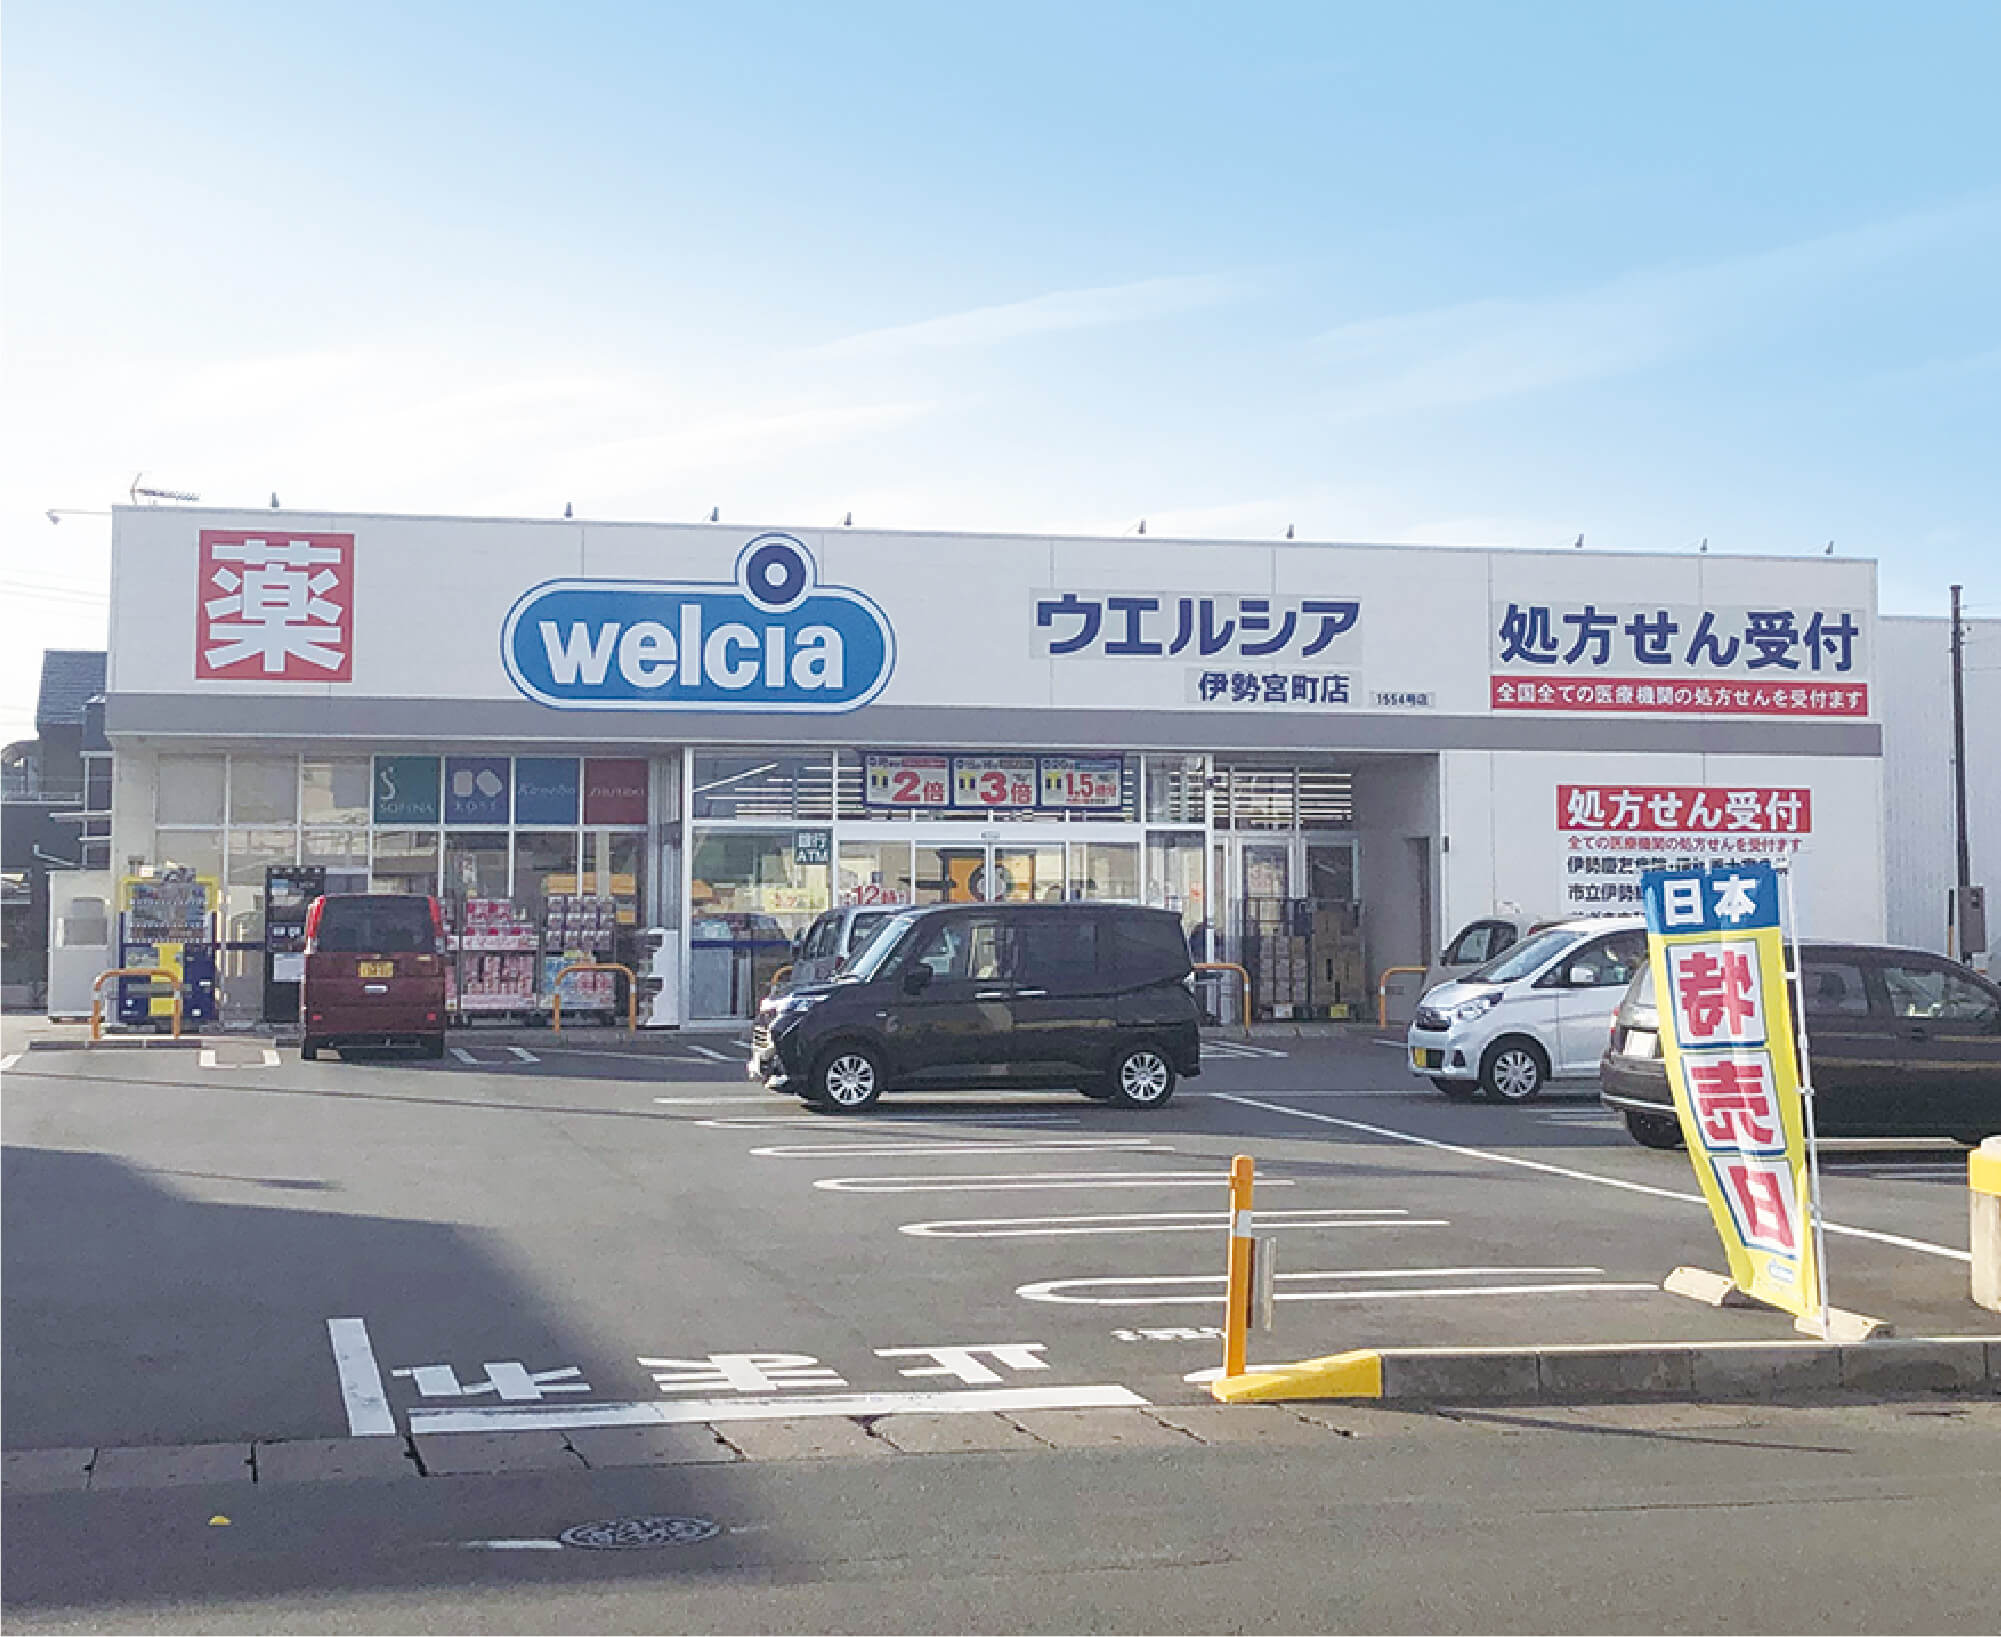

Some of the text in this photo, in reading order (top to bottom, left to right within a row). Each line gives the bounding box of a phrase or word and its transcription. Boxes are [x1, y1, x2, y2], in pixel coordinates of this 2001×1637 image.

[203, 538, 346, 673] 薬
[1036, 593, 1361, 658] ウエルシア
[537, 602, 844, 690] welcia
[1499, 603, 1859, 672] 処方せん受付
[1198, 670, 1350, 704] 伊勢宮町店
[1495, 682, 1864, 709] 全国全ての医療機関の処方せんを受付ます
[1567, 788, 1803, 831] 処方せん受付
[796, 849, 827, 862] ATM
